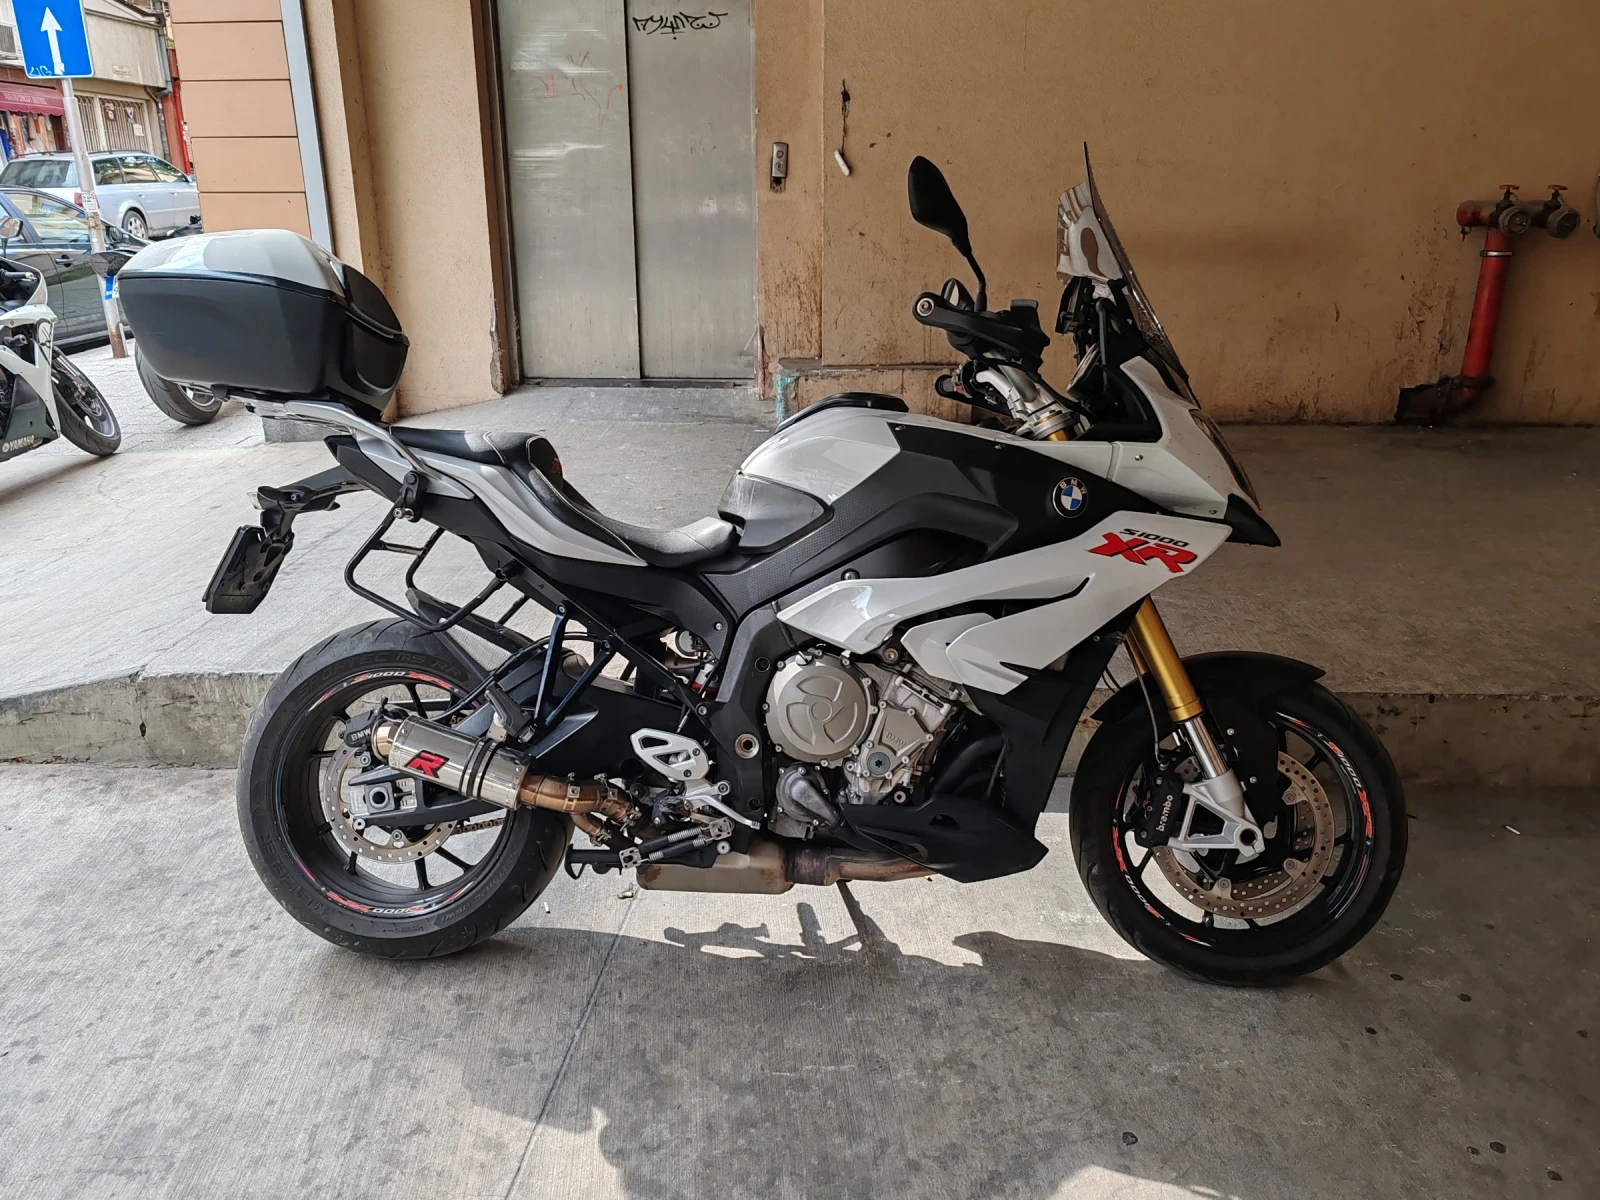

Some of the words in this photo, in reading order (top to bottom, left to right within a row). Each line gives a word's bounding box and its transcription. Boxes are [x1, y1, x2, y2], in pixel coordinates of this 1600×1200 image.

[9, 434, 35, 452] YAMAHA
[1118, 528, 1191, 548] S1000
[1085, 531, 1199, 574] XR
[300, 651, 389, 698] SPORTEC
[351, 728, 371, 741] BMW
[885, 731, 907, 746] BMW
[1156, 794, 1174, 832] brembo
